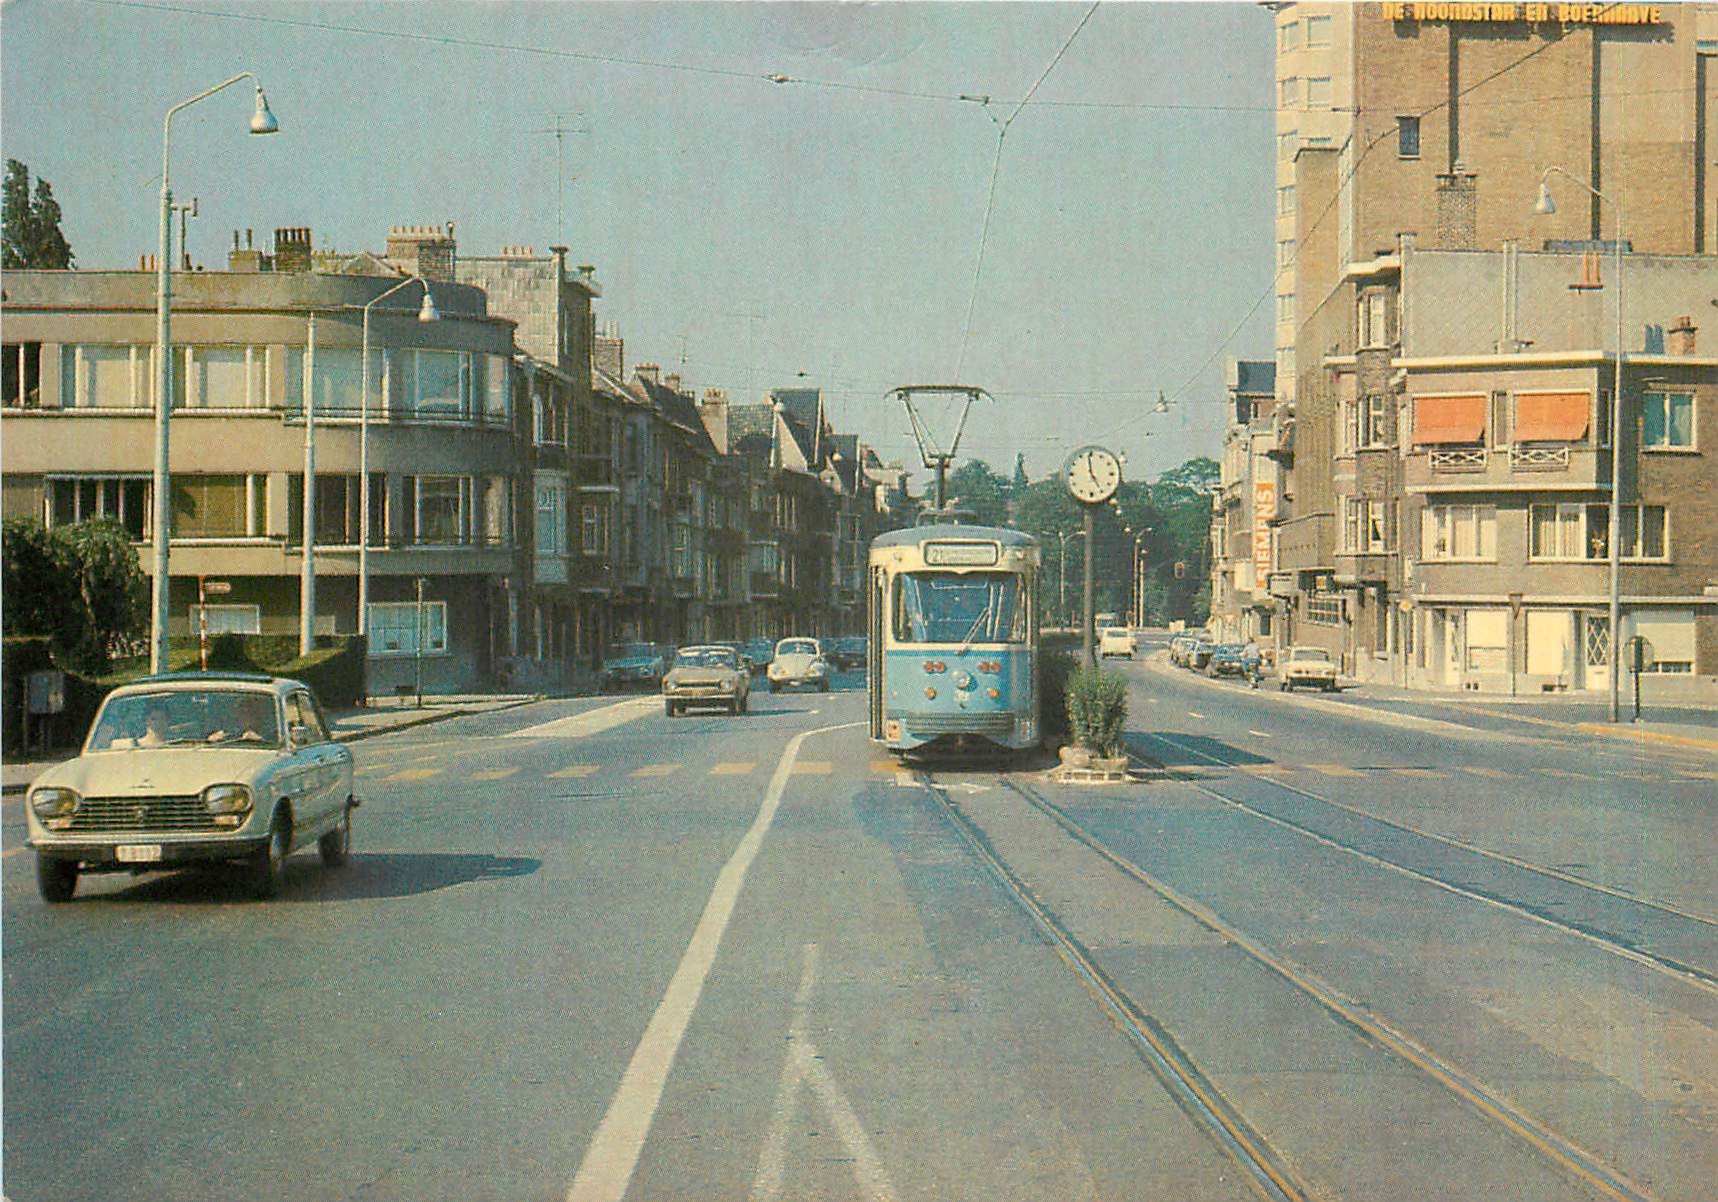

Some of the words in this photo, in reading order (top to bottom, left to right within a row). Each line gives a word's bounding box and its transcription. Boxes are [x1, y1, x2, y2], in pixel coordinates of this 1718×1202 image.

[1382, 2, 1404, 20] DE
[1413, 2, 1515, 22] NOORDSTAR
[1526, 3, 1548, 22] EN
[1256, 490, 1274, 580] SIEMENS
